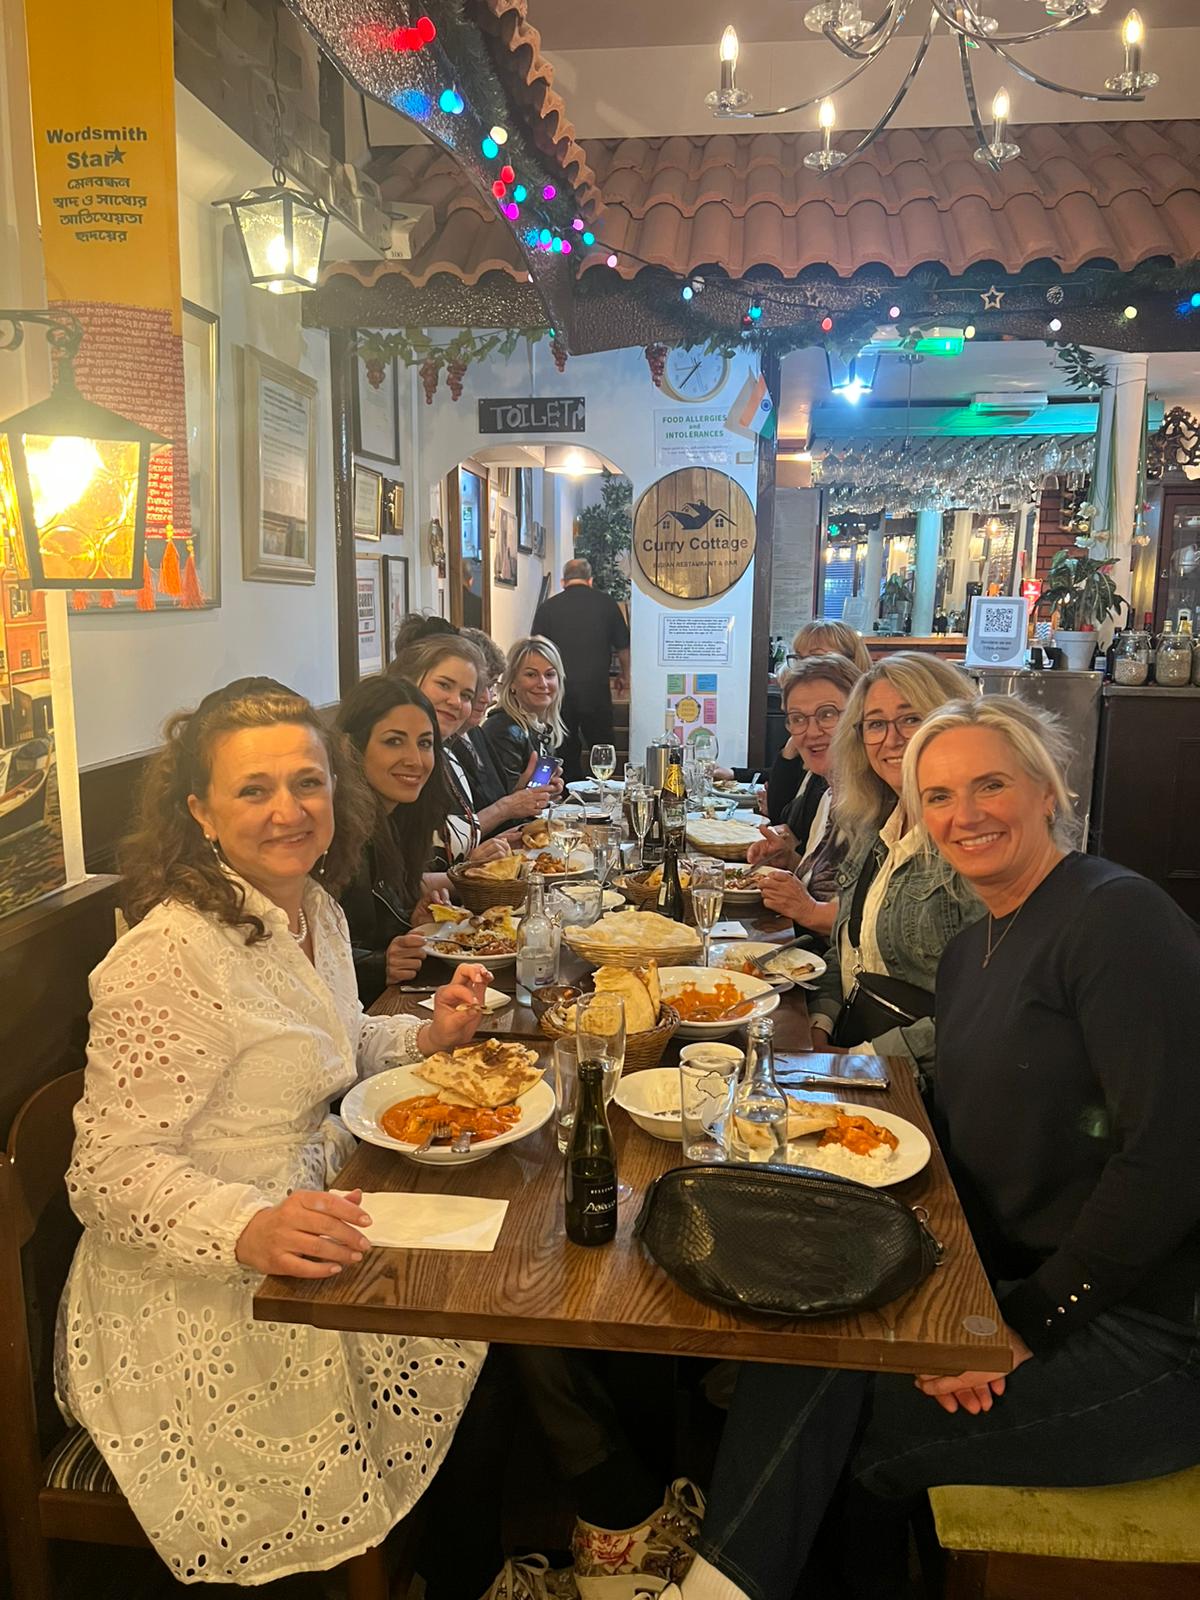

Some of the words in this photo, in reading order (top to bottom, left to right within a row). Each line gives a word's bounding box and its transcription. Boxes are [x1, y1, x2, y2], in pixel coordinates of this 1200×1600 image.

[46, 126, 148, 144] Wordsmith
[66, 151, 114, 169] Star
[82, 194, 93, 206] ও
[489, 400, 575, 430] TOILET
[662, 416, 684, 424] FOOD
[685, 414, 728, 423] ALLERGIES
[665, 430, 724, 439] INTOLERANCES
[642, 539, 685, 554] Curry
[689, 537, 748, 552] Cottage
